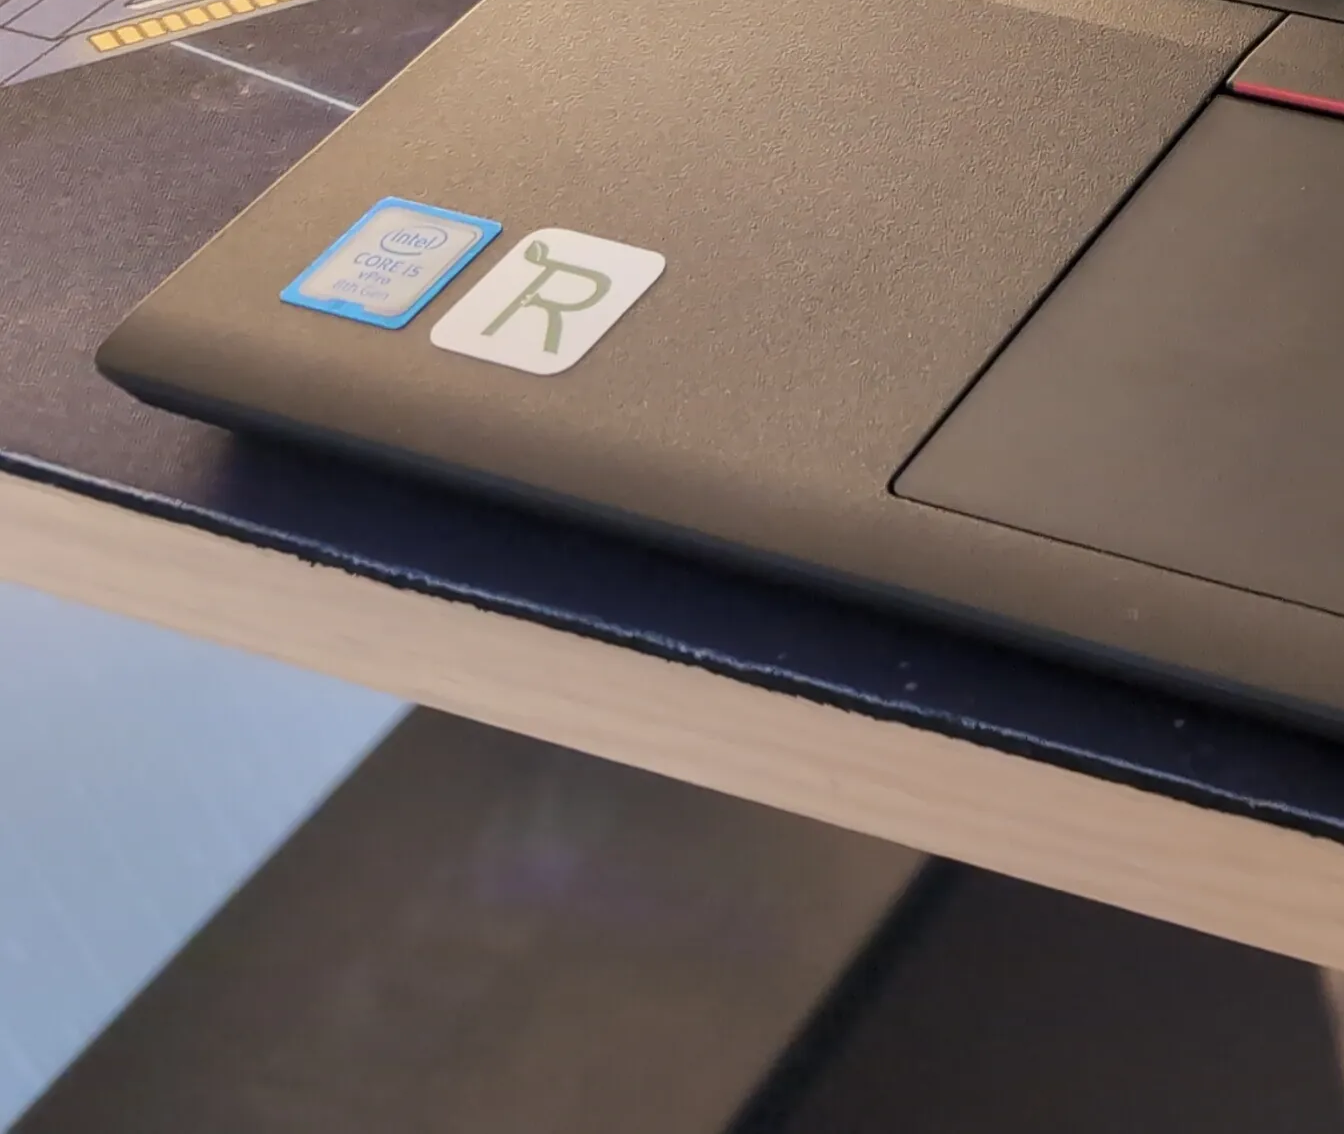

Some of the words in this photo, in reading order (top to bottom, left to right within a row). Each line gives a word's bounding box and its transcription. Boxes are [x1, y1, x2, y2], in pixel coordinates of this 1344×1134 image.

[353, 252, 404, 273] CORE
[358, 270, 392, 286] vPro
[480, 240, 613, 355] R
